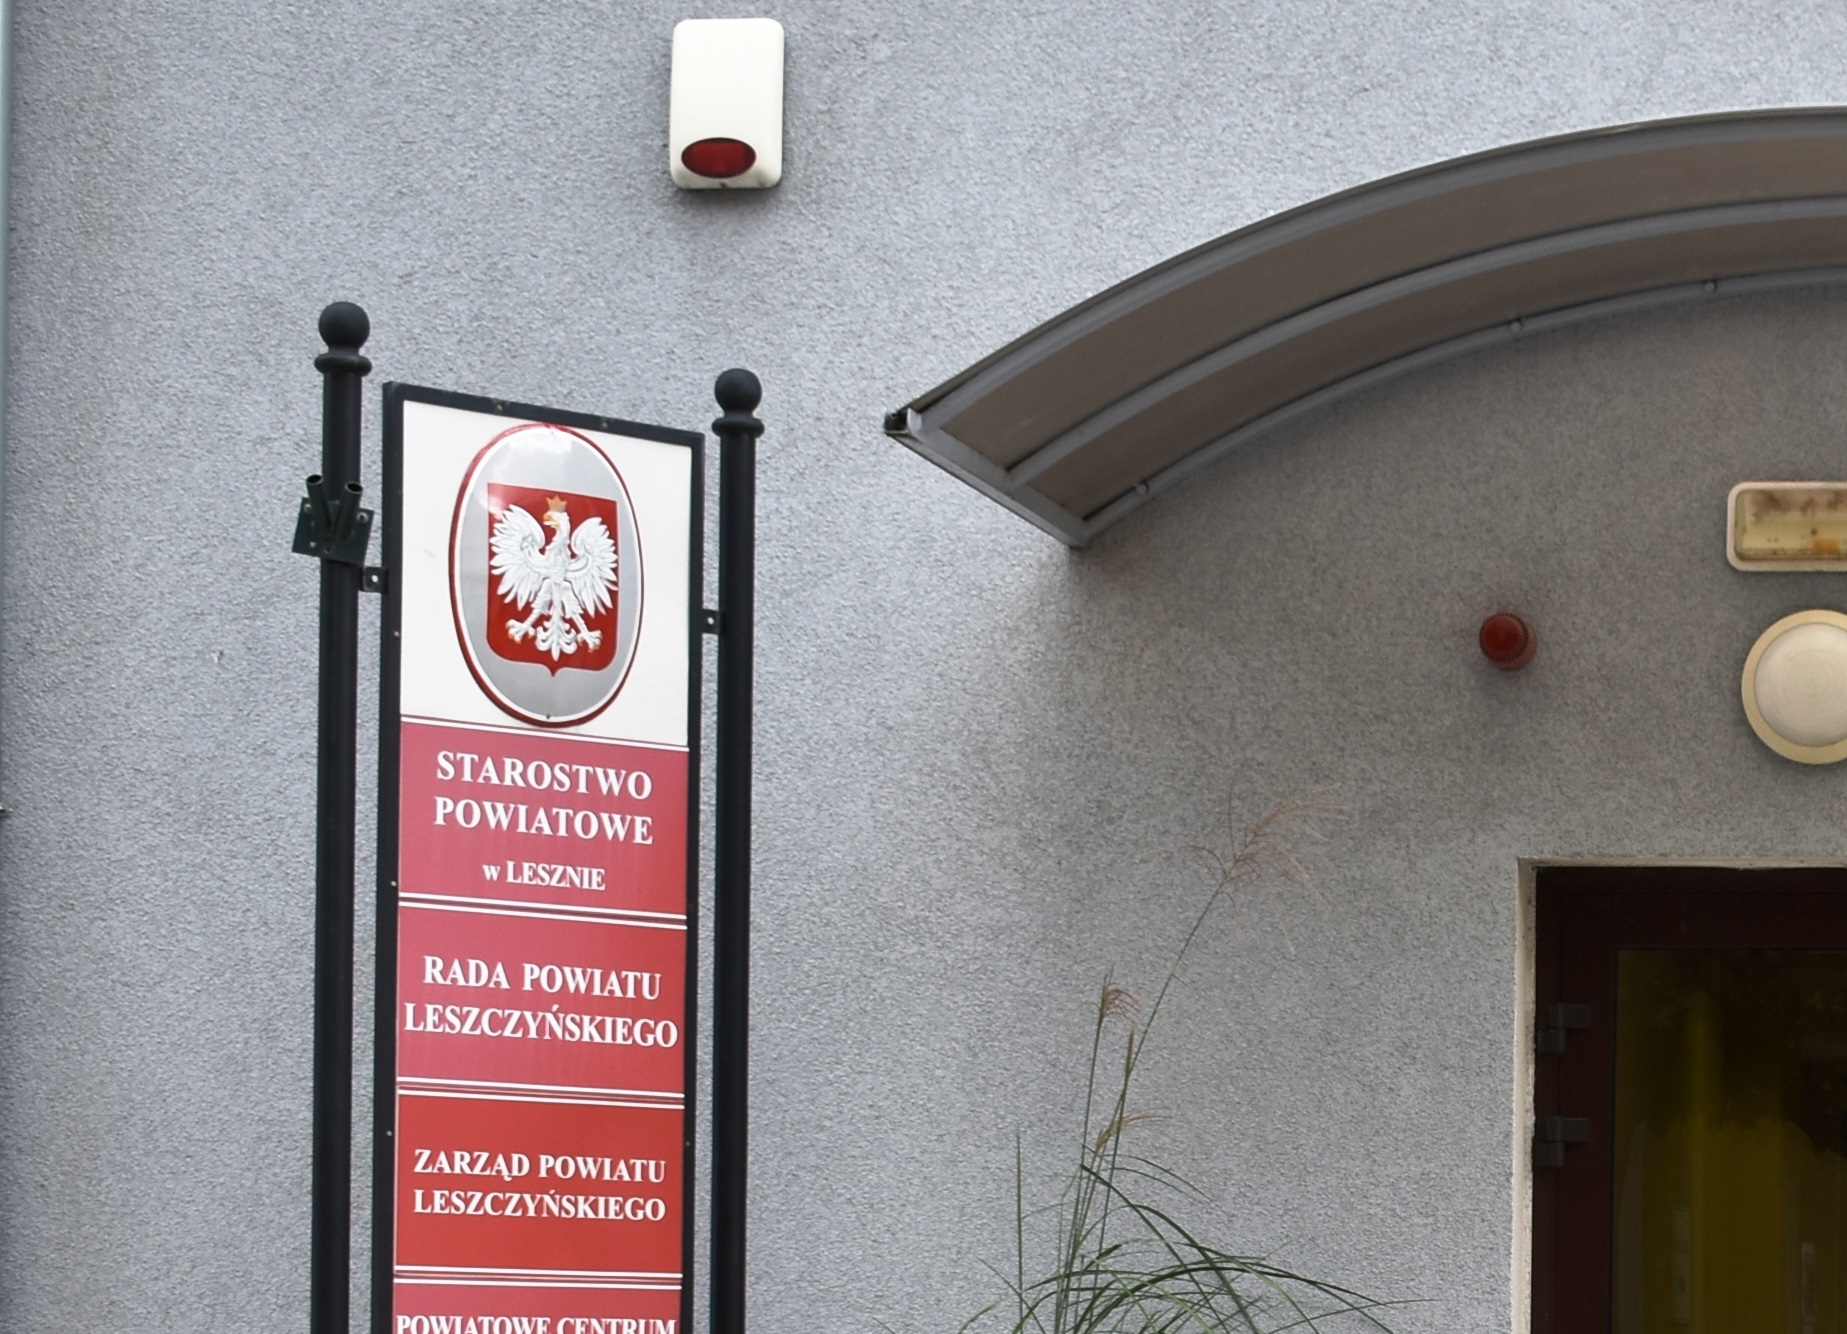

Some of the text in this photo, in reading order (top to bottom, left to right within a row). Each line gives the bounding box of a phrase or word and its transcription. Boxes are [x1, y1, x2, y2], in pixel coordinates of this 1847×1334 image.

[437, 751, 651, 800] STAROSTWO
[434, 796, 653, 845] POWIATOWE
[483, 861, 606, 891] w LESZNIE
[423, 956, 661, 1000] RADA POWIATU
[404, 1001, 678, 1048] LESZCZYŃSKIEGO
[414, 1148, 666, 1184] ZARZĄD POWIATU
[413, 1187, 666, 1222] LESZCZYŃSKIEGO
